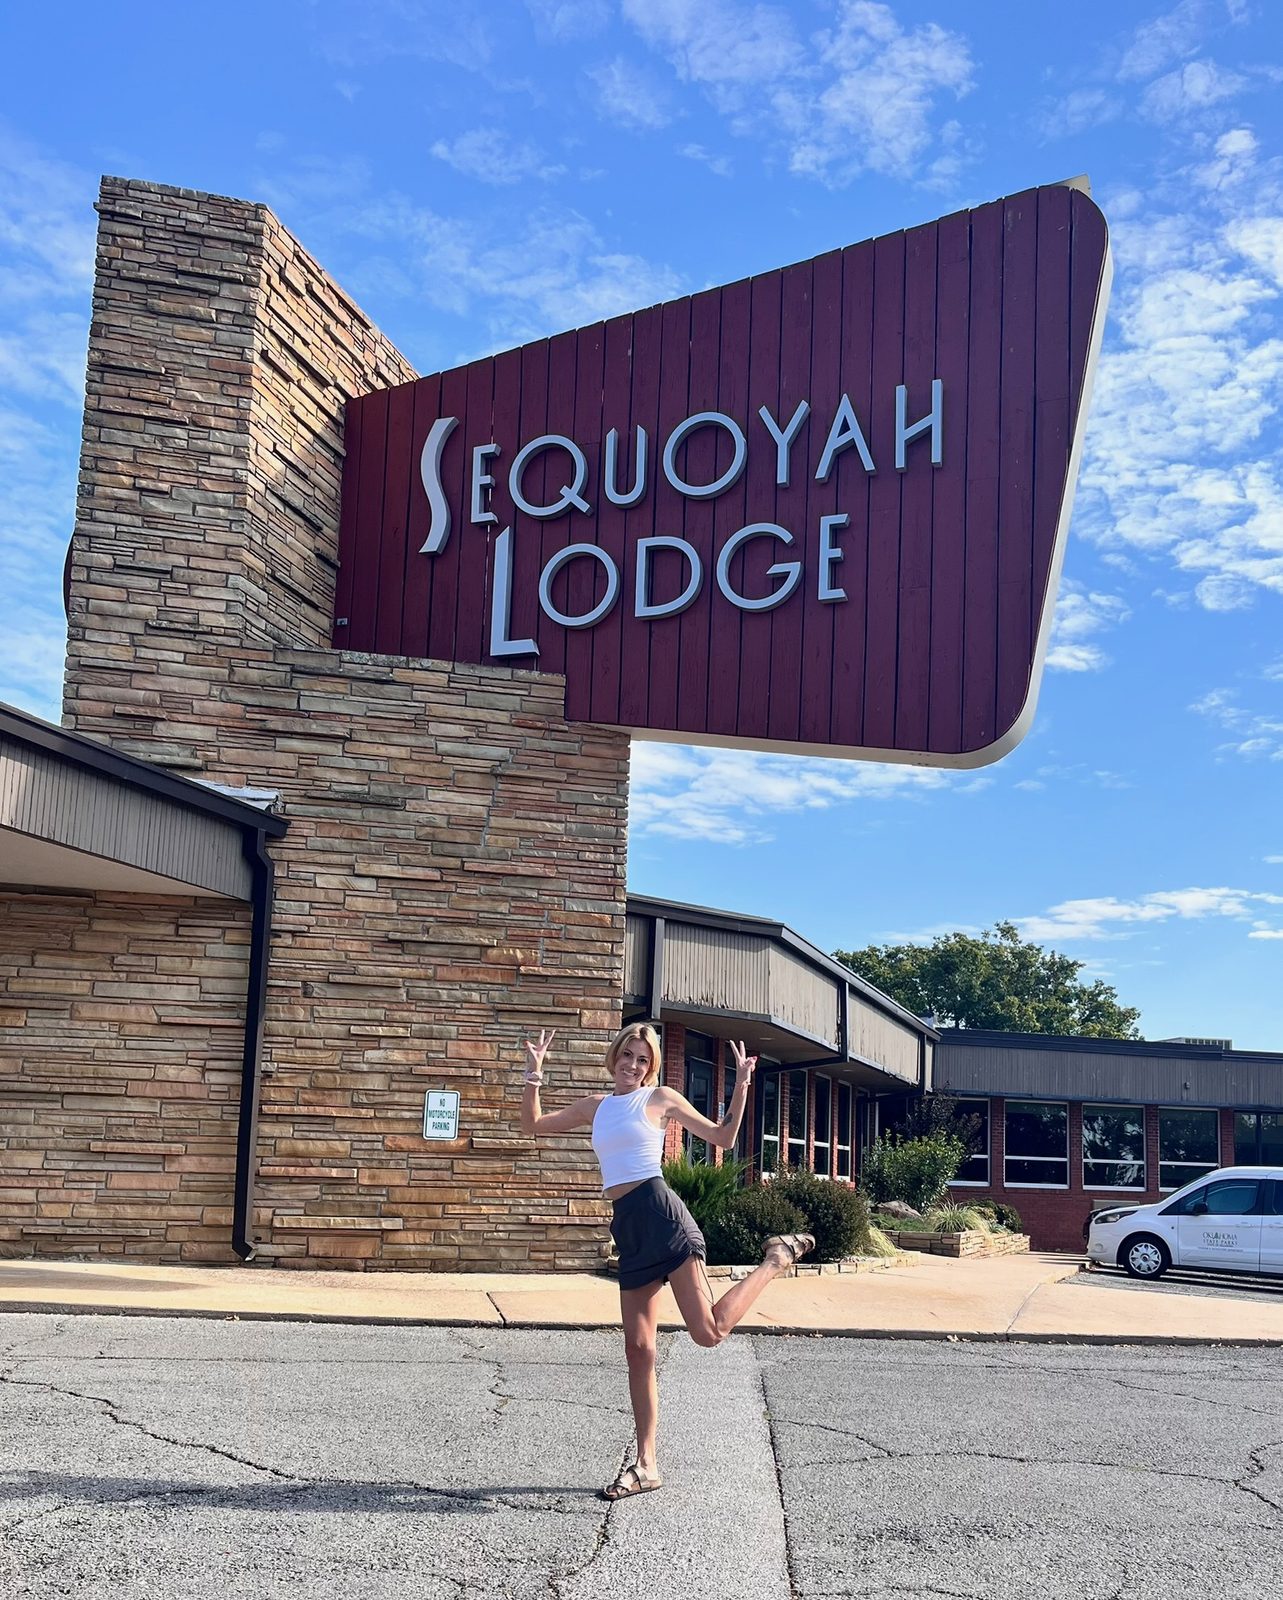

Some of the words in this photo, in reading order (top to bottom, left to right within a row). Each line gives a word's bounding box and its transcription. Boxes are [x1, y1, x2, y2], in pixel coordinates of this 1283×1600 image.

[418, 379, 943, 556] SEQUOYAH
[489, 513, 851, 657] LODGE
[439, 1098, 446, 1107] NO
[428, 1109, 455, 1119] MOTORCYCLE
[432, 1121, 450, 1131] PARKING
[1202, 1232, 1238, 1240] OKLAHOMA
